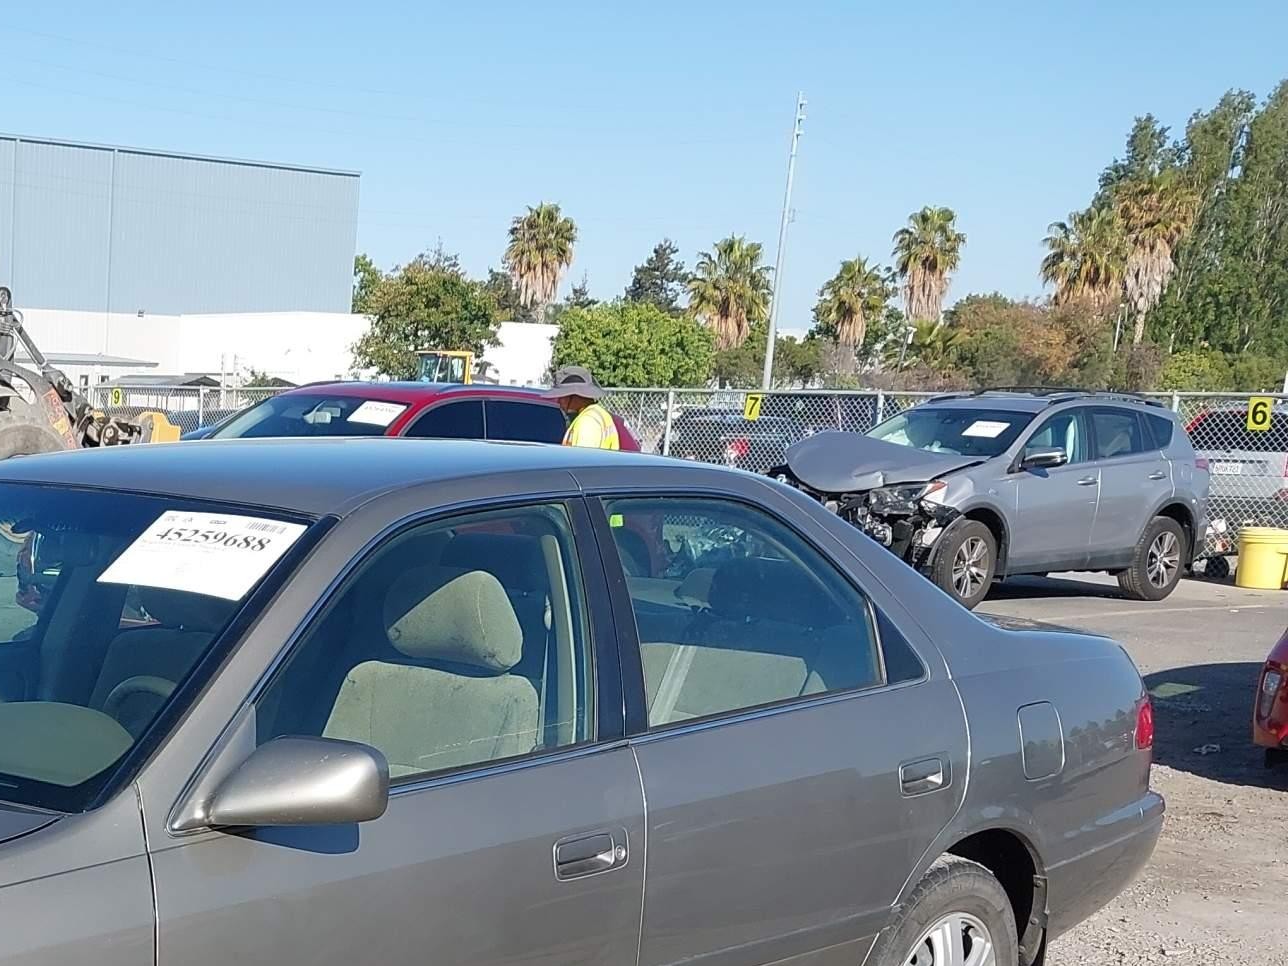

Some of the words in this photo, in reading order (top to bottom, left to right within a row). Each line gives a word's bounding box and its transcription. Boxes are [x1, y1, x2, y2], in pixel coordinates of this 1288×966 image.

[113, 390, 120, 404] 9
[749, 396, 759, 415] 7
[1252, 401, 1268, 425] 6
[156, 527, 272, 552] 45259688
